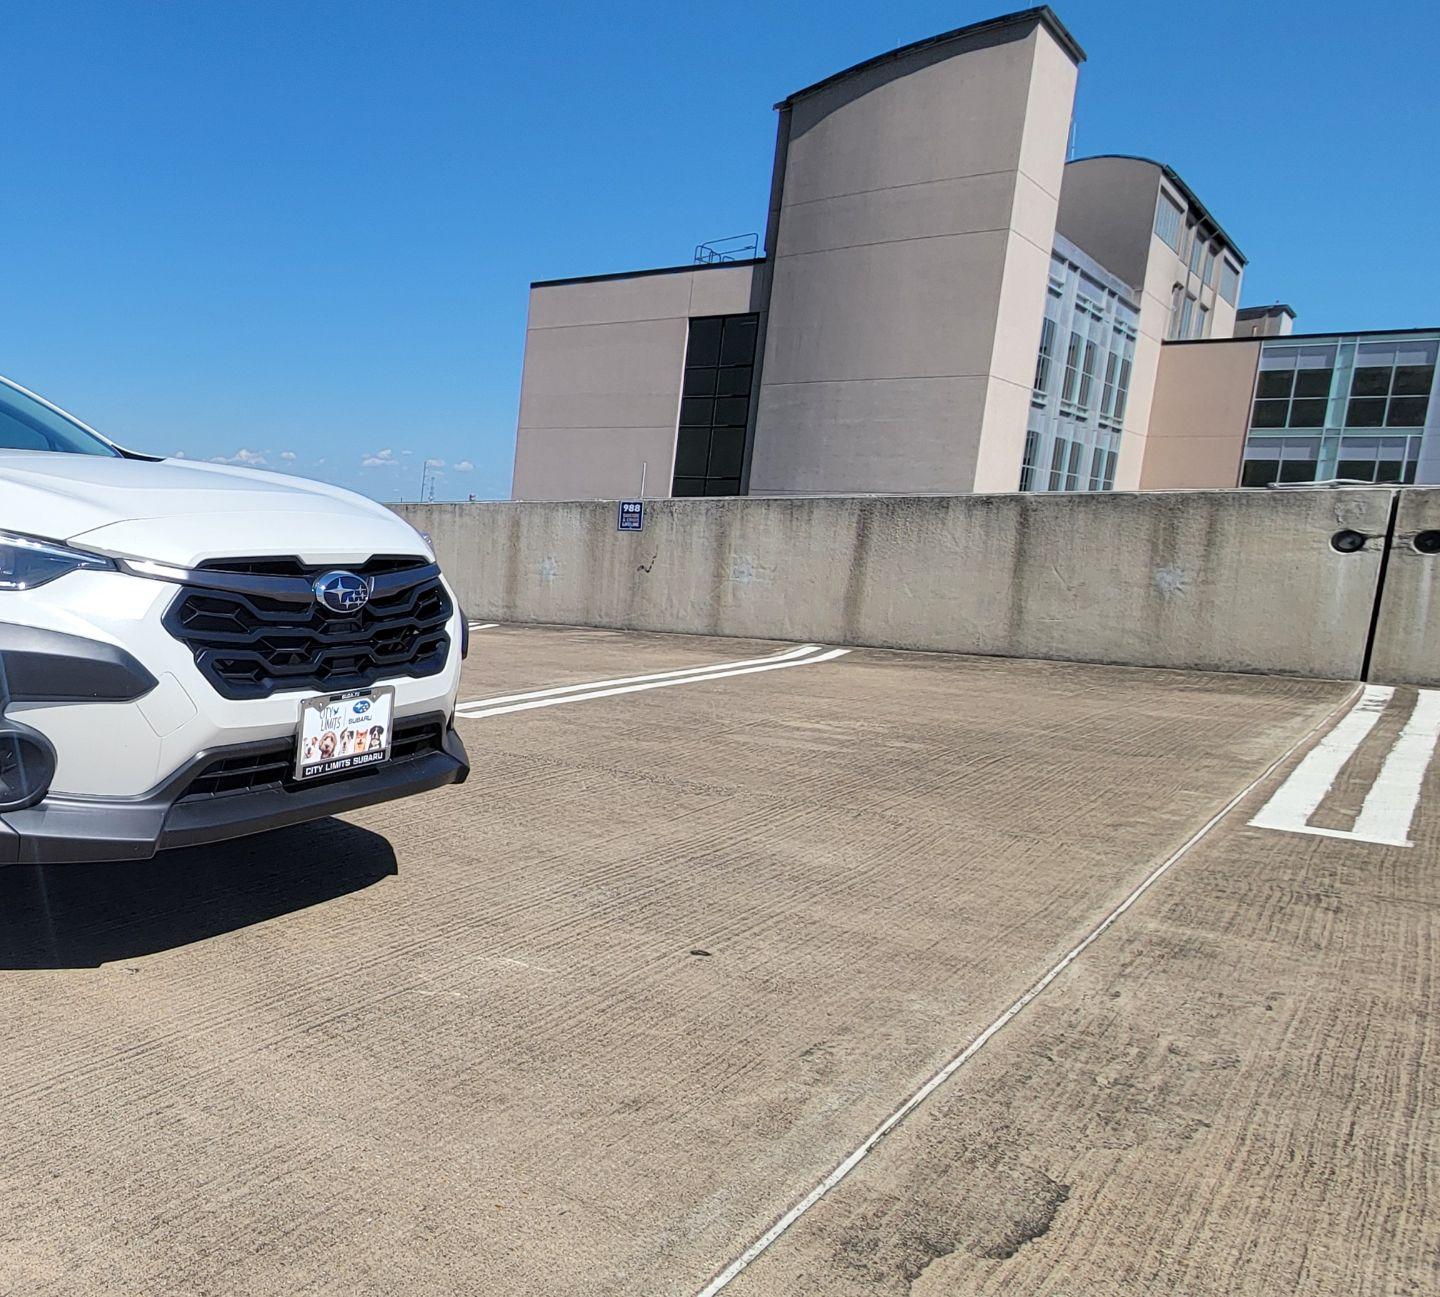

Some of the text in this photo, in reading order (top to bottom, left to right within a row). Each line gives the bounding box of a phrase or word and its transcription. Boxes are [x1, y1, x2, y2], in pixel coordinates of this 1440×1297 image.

[623, 504, 641, 512] 988
[321, 717, 341, 731] LIMITS
[348, 715, 372, 724] SUBARU
[305, 752, 383, 776] CITY LIMITS SUBARU
